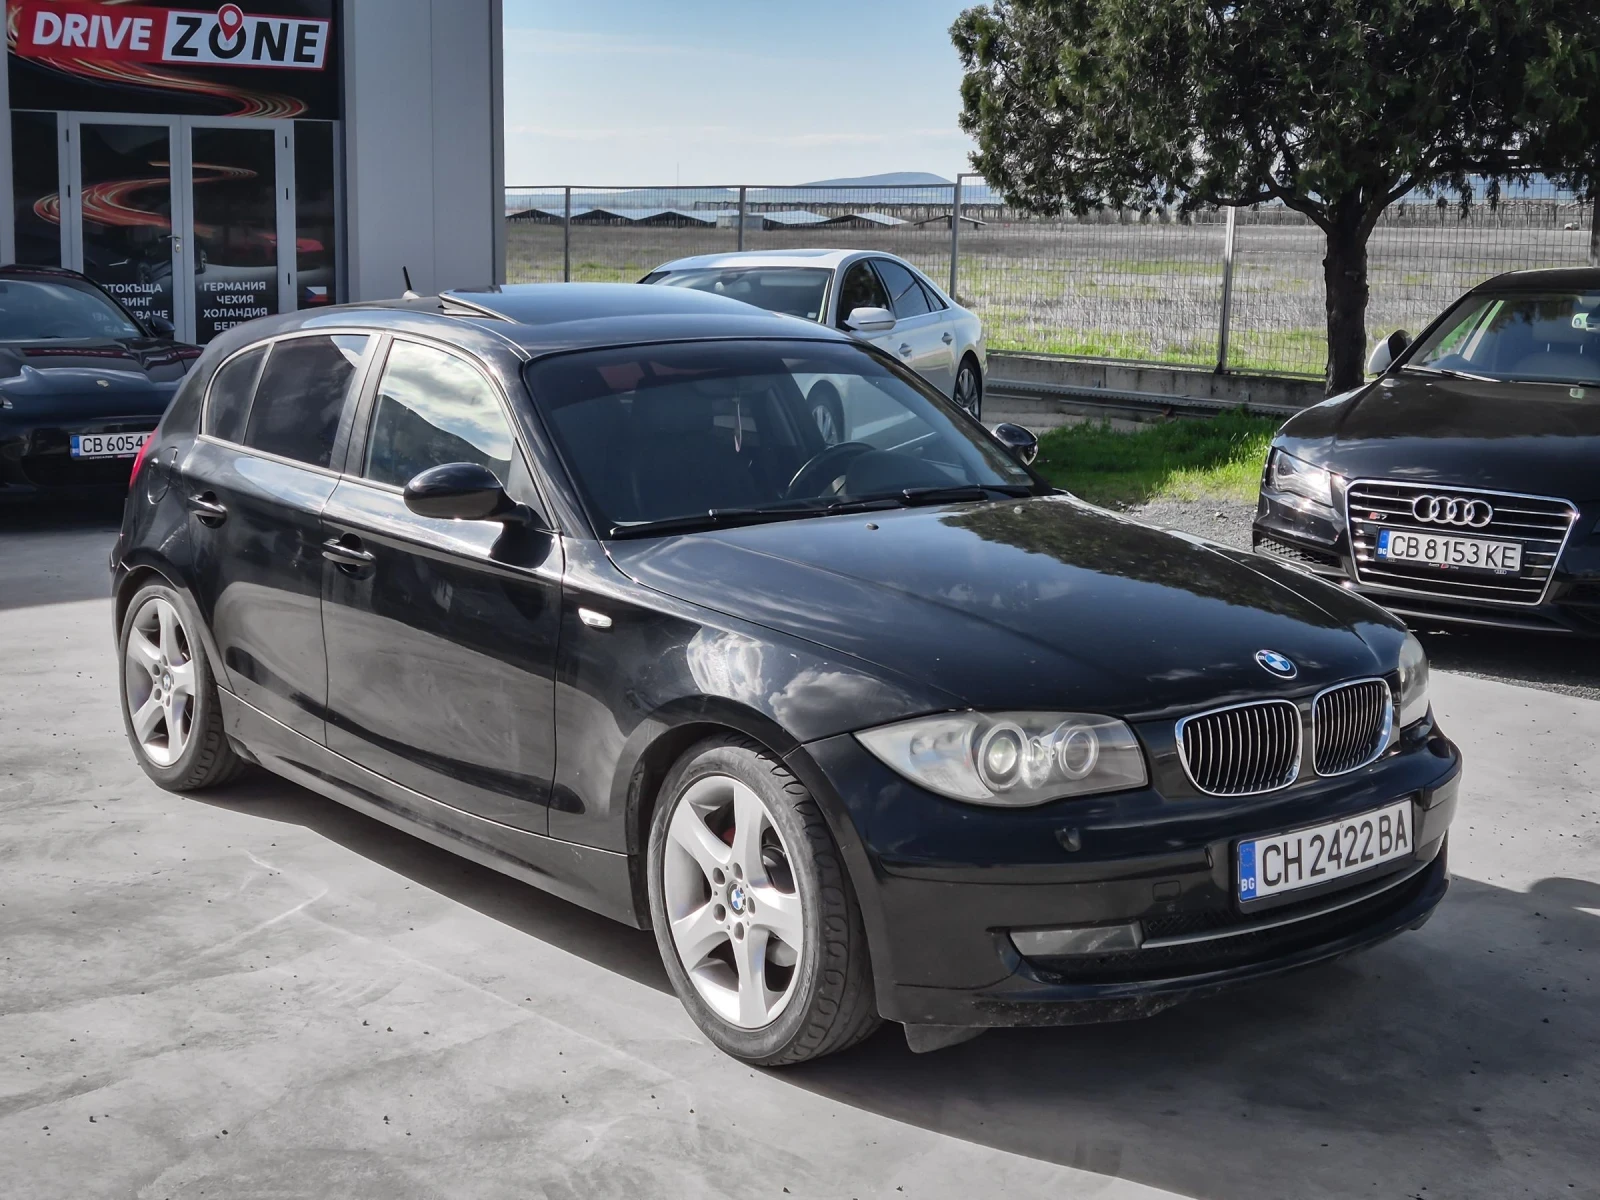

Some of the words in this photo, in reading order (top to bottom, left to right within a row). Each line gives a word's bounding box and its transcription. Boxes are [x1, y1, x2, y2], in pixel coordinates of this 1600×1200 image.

[32, 11, 153, 51] DRIVE
[171, 16, 320, 63] ZONE
[203, 281, 266, 292] ГЕРМАНИЯ
[216, 294, 254, 304] ЧЕХИЯ
[203, 307, 268, 318] ХОЛАНДИЯ
[82, 437, 103, 453] CB
[106, 435, 144, 452] 6054
[1392, 535, 1420, 558] CB
[1425, 539, 1480, 565] 8153
[1485, 545, 1517, 569] KE
[1262, 838, 1303, 887] CH
[1309, 820, 1374, 877] 2422
[1379, 810, 1408, 857] BA
[1241, 877, 1255, 892] BG
